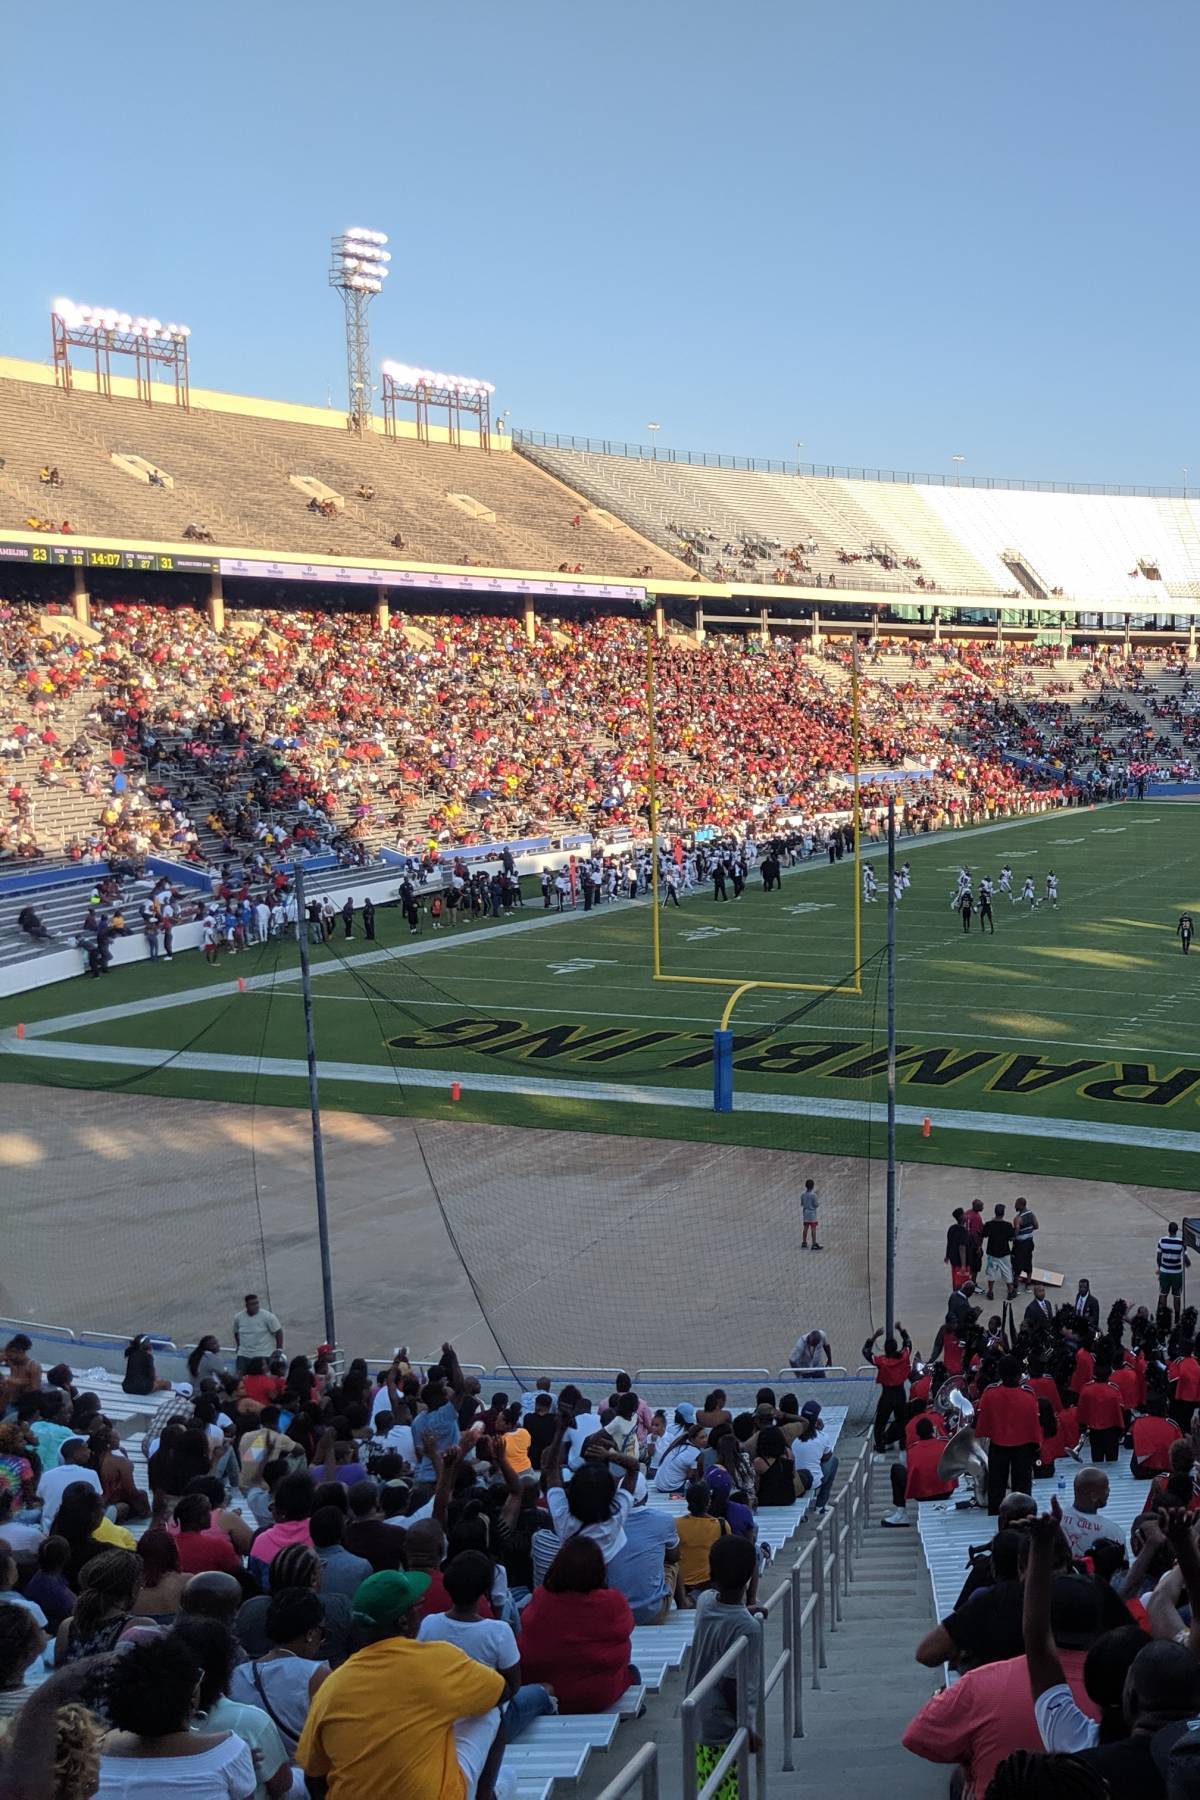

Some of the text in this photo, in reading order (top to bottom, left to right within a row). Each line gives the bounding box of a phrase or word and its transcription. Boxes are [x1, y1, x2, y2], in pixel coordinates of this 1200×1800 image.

[32, 548, 47, 561] 23
[58, 555, 65, 563] 3
[73, 555, 83, 564] 13
[91, 553, 120, 566] 14:07
[128, 559, 133, 568] 3
[141, 560, 151, 568] 27
[161, 557, 173, 569] 31
[1077, 1519, 1103, 1532] CREW
